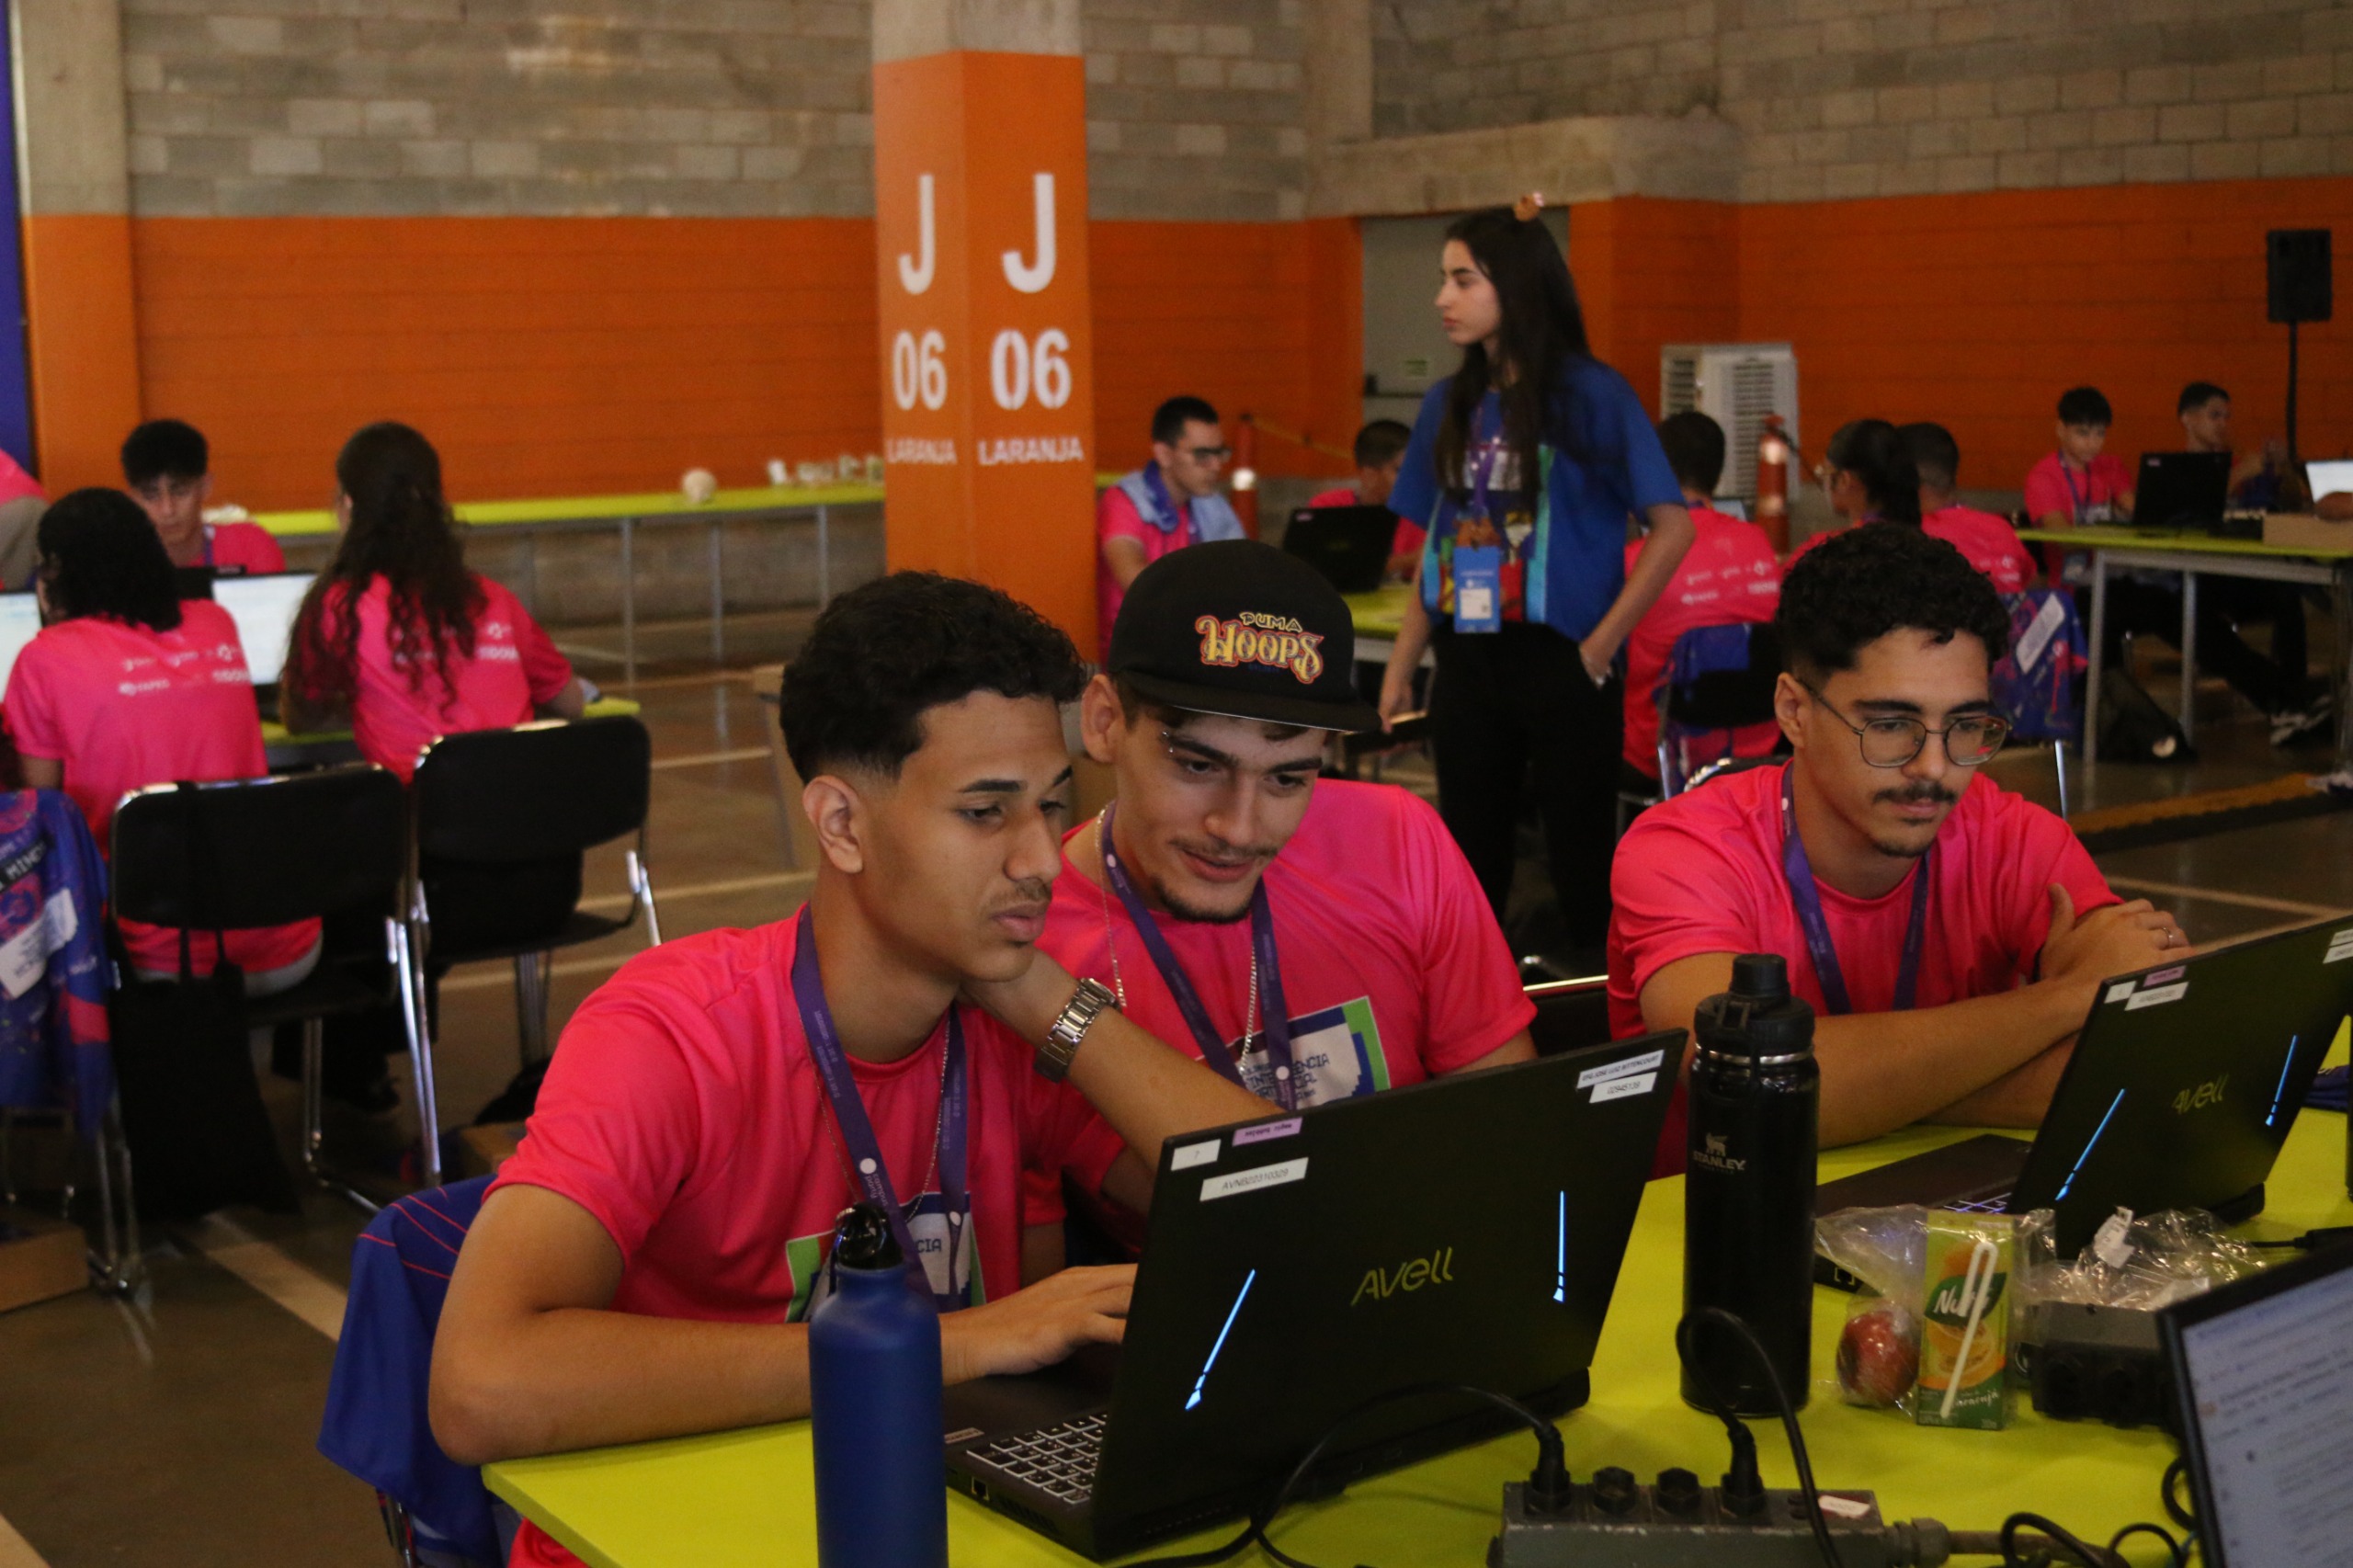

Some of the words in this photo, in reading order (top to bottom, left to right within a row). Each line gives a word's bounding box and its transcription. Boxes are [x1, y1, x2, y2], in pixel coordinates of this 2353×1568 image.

[898, 172, 936, 295] J
[1003, 173, 1056, 293] J
[894, 330, 947, 411] 06
[992, 329, 1071, 410] 06
[885, 437, 957, 465] LARANJA
[977, 436, 1085, 466] LARANJA
[1239, 611, 1303, 633] PUMA
[1693, 1150, 1746, 1171] STANLEY
